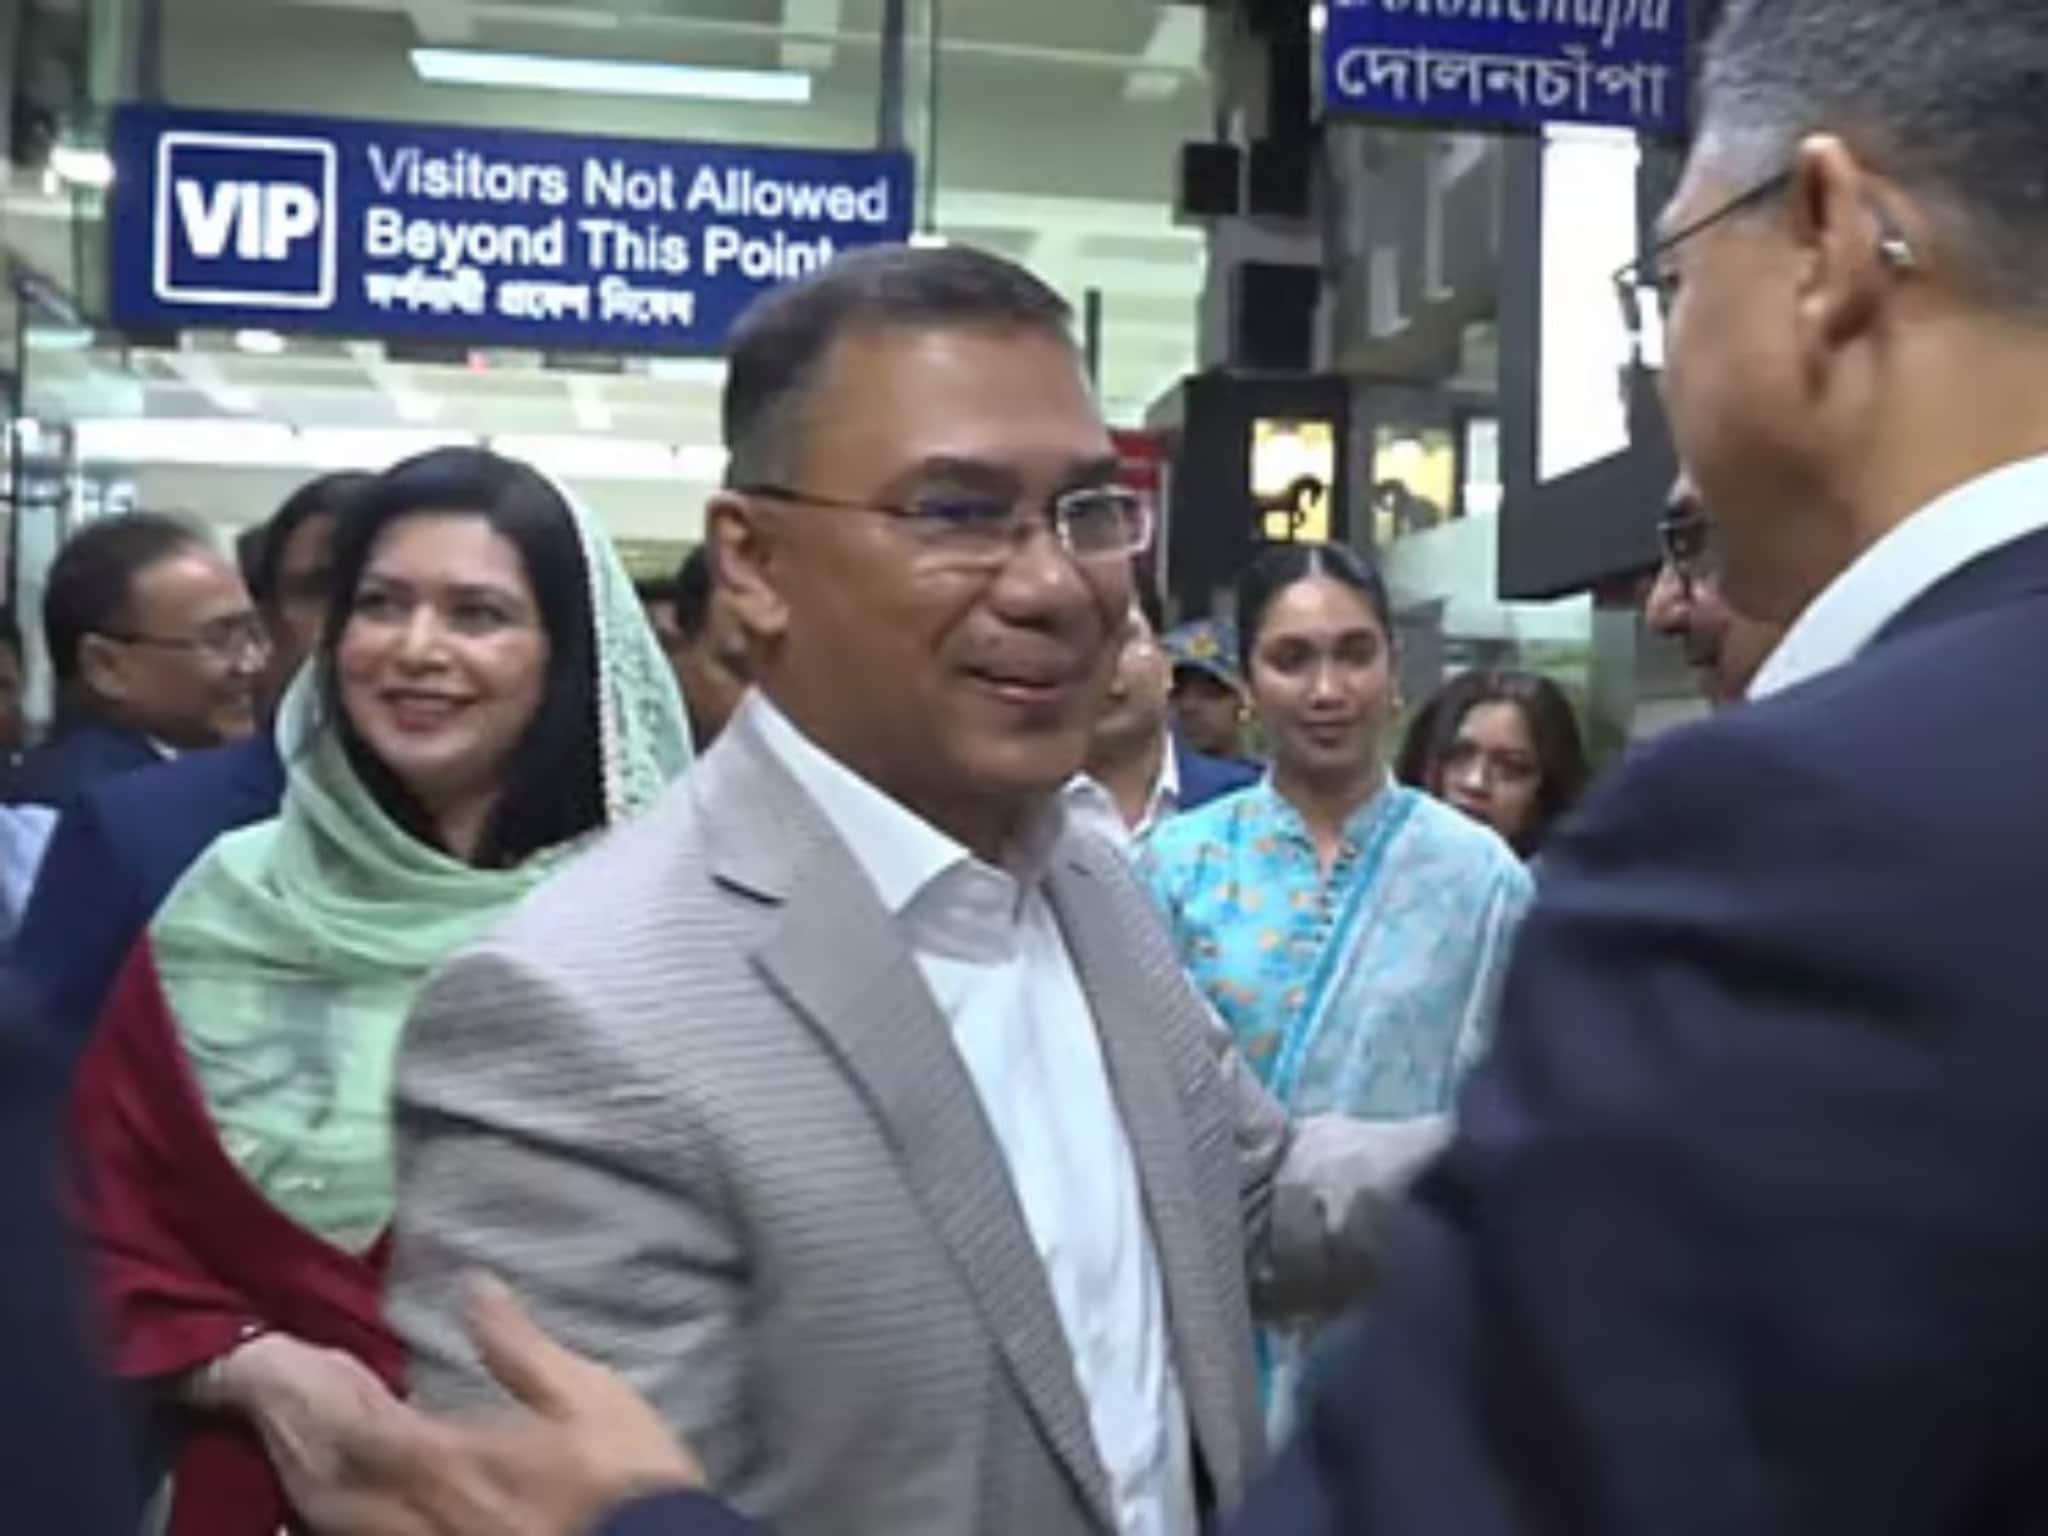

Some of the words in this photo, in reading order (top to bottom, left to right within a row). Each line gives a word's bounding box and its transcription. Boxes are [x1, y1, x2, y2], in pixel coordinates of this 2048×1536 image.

[1336, 43, 1670, 117] দোলনচাঁপা
[175, 179, 320, 261] VIP
[367, 145, 568, 205] Visitors
[582, 157, 676, 213] Not
[685, 165, 889, 223] Allowed
[365, 207, 566, 271] Beyond
[577, 218, 690, 275] This
[703, 225, 835, 280] Point
